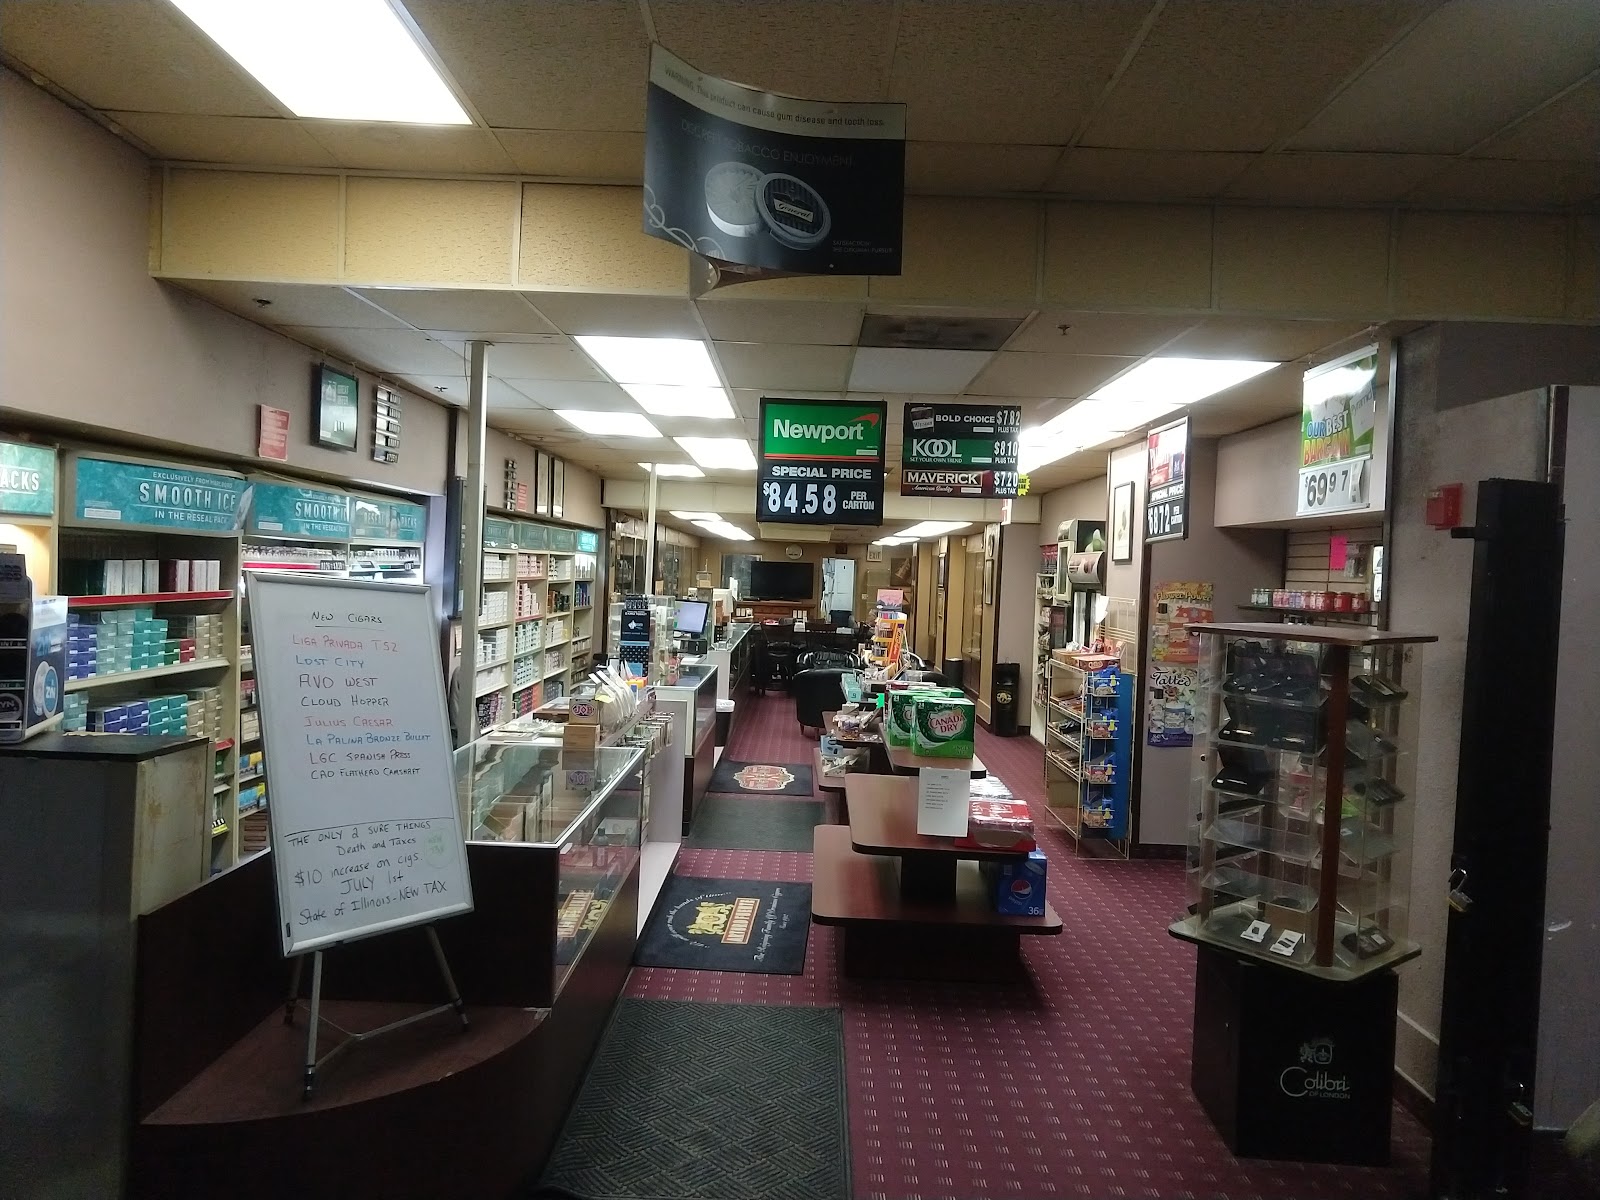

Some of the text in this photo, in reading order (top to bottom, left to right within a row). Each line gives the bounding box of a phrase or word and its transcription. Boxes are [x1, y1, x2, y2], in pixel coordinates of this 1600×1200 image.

[710, 93, 736, 108] product
[738, 102, 751, 112] can
[753, 107, 774, 117] cause
[777, 112, 792, 121] gum
[795, 113, 825, 124] disease
[828, 117, 842, 125] and
[845, 117, 865, 126] tooth
[724, 136, 780, 161] OBACCO
[779, 203, 811, 218] General
[935, 414, 995, 423] BOLD CHOICE
[1307, 411, 1349, 439] OUR BEST
[773, 418, 864, 443] Newport
[912, 438, 962, 458] KOOL
[994, 440, 1019, 456] $8.10
[153, 471, 194, 483] EXCLUSIVELY
[195, 477, 210, 485] FROM
[771, 466, 872, 479] SPECIAL PRICE
[907, 472, 978, 484] MAVERICK
[139, 482, 236, 512] SMOOTH ICE
[850, 490, 867, 501] PER
[1169, 483, 1184, 496] PRICE
[763, 482, 837, 515] $84.58
[843, 500, 875, 511] CARTON
[155, 510, 165, 519] IN
[168, 511, 185, 521] THE
[187, 513, 213, 524] RESEAL
[295, 501, 340, 522] SMOOTH
[869, 551, 881, 559] EXIT
[311, 611, 383, 624] NEW CIGARS
[292, 634, 317, 646] LIGA
[322, 634, 363, 650] PRIVADA
[295, 654, 364, 669] LOST CITY
[299, 673, 379, 689] AVO WEST
[301, 694, 390, 707] CLOUD HOPPER
[574, 704, 594, 716] JOB
[304, 715, 394, 727] JULIUS CAESAR
[940, 723, 958, 733] DRY
[306, 731, 431, 745] LA PALINA BRONZE BULLET
[309, 748, 411, 765] LGC SPANISH PRESS
[311, 767, 421, 780] CAO FLATHEAD CAMSHAFT
[288, 821, 431, 847] THE ONLY 2 SURE THINGS
[336, 837, 417, 856] Death and Taxes
[294, 869, 323, 887] $10
[331, 862, 370, 878] increase
[376, 859, 390, 868] on
[340, 870, 404, 895] JULY 1st
[299, 908, 327, 925] State
[334, 902, 345, 916] of
[423, 880, 447, 893] TAX
[733, 899, 755, 920] FUENTE
[1027, 906, 1040, 916] 36
[754, 951, 766, 962] The
[761, 919, 775, 934] Family
[1280, 1066, 1350, 1097] Colibri
[1320, 1091, 1351, 1099] LONDON
